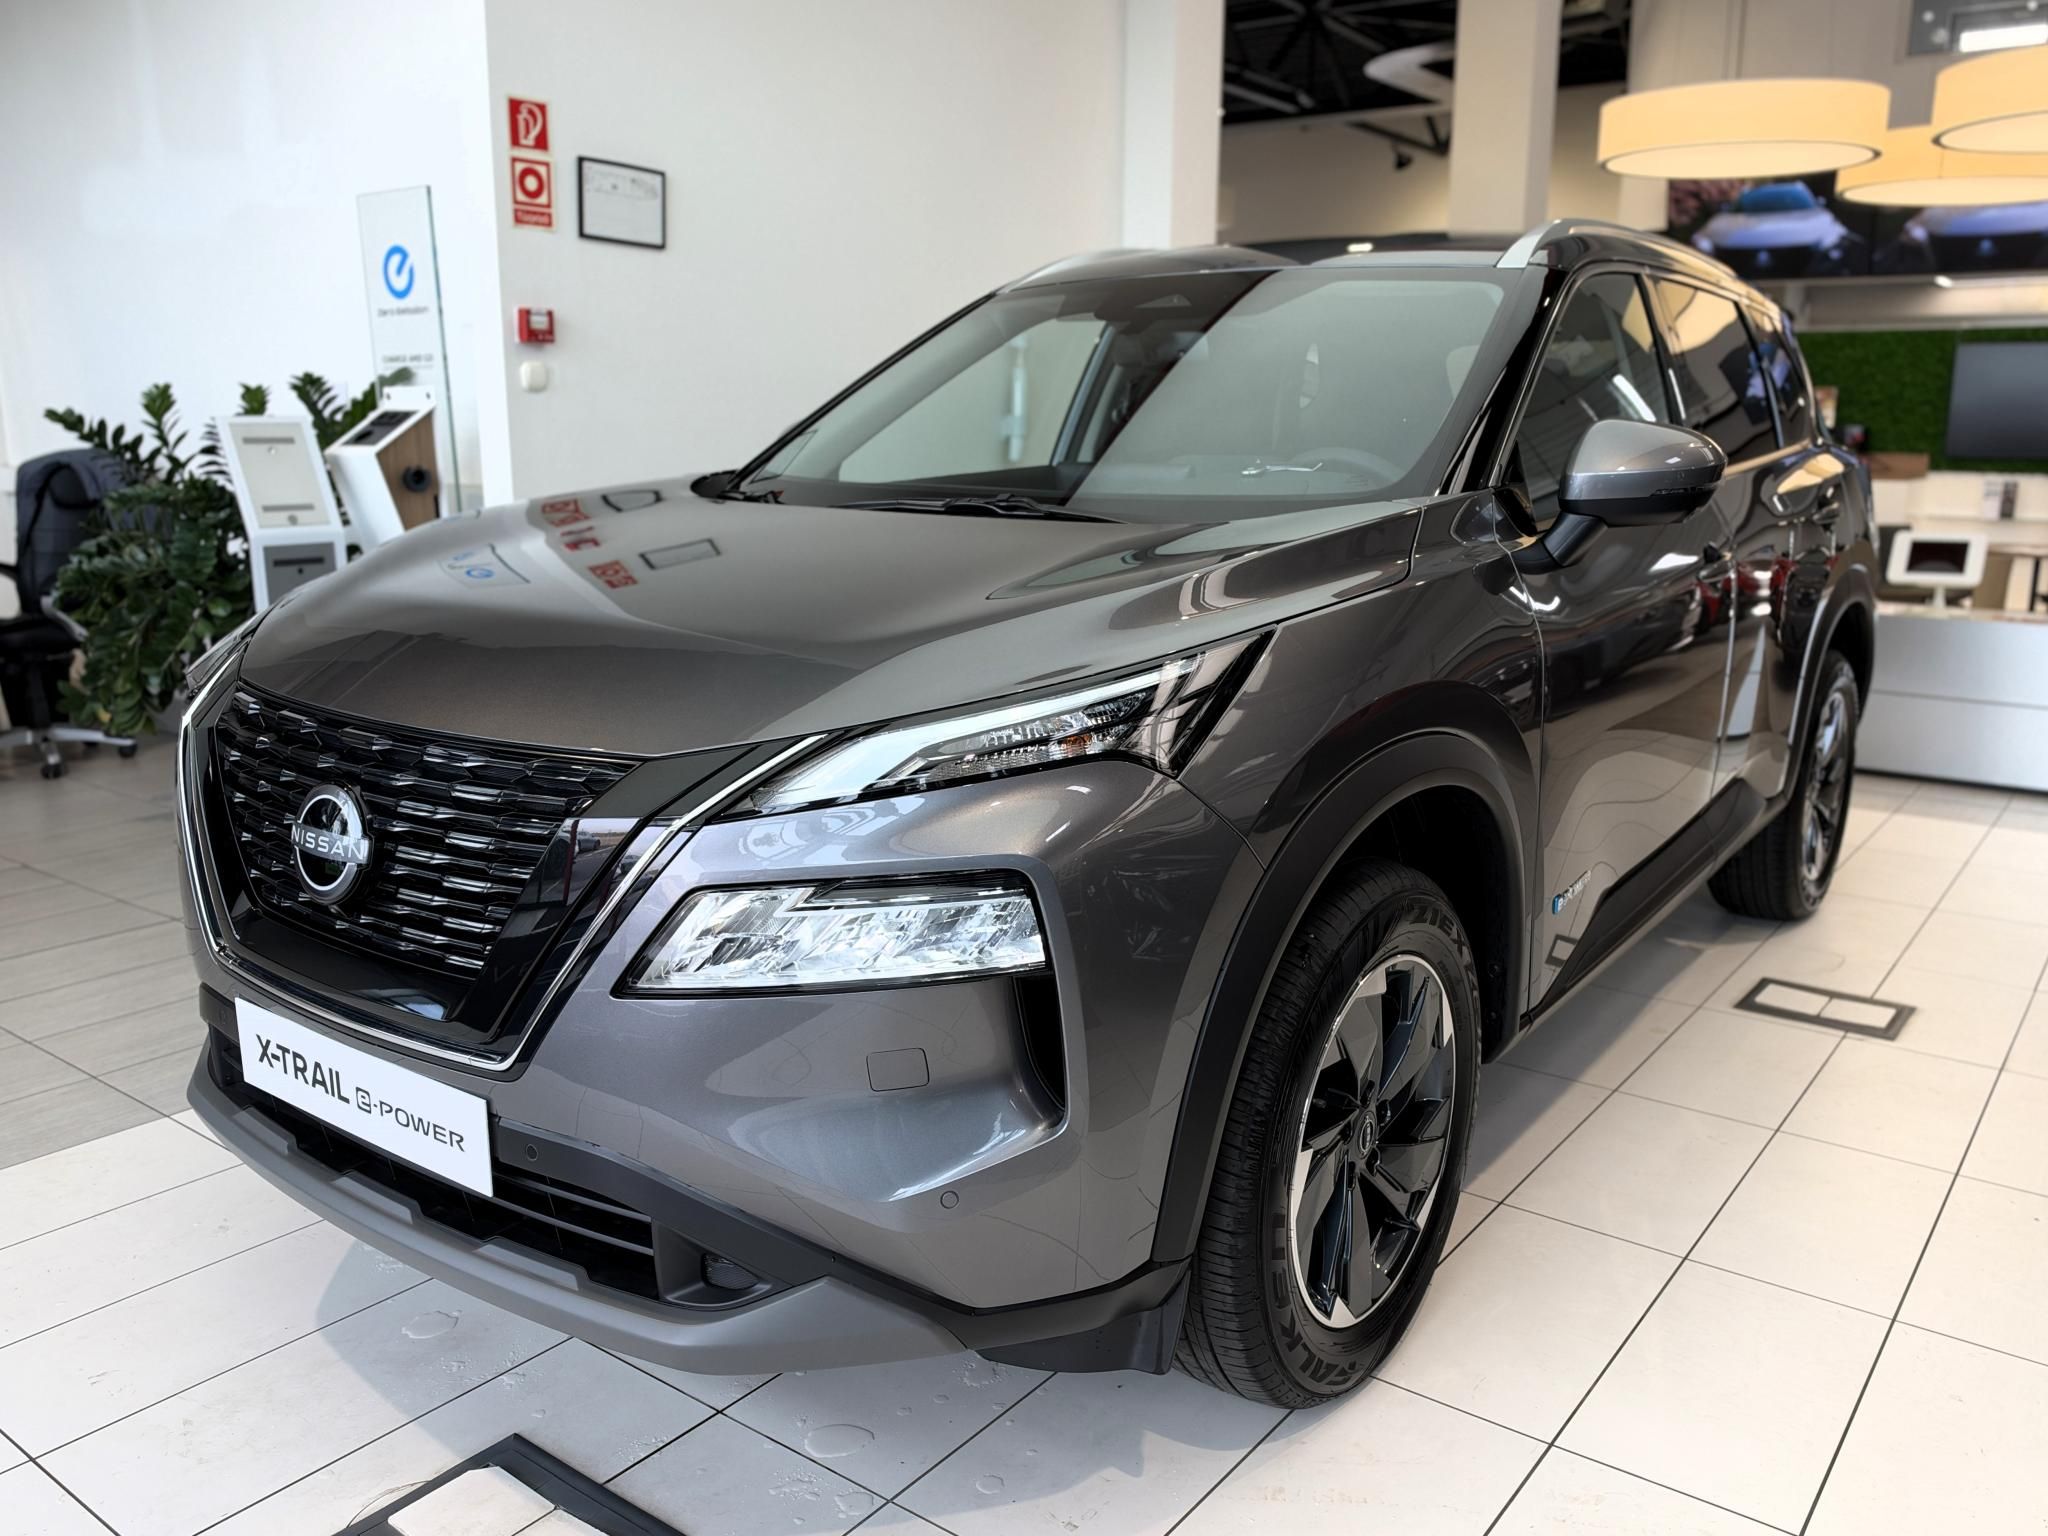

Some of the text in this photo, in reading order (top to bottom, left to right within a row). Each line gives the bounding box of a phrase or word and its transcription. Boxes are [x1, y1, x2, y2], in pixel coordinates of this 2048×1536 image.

[291, 824, 365, 860] NISSAN
[1409, 905, 1466, 957] ZIEX
[255, 1033, 350, 1105] X-TRAIL
